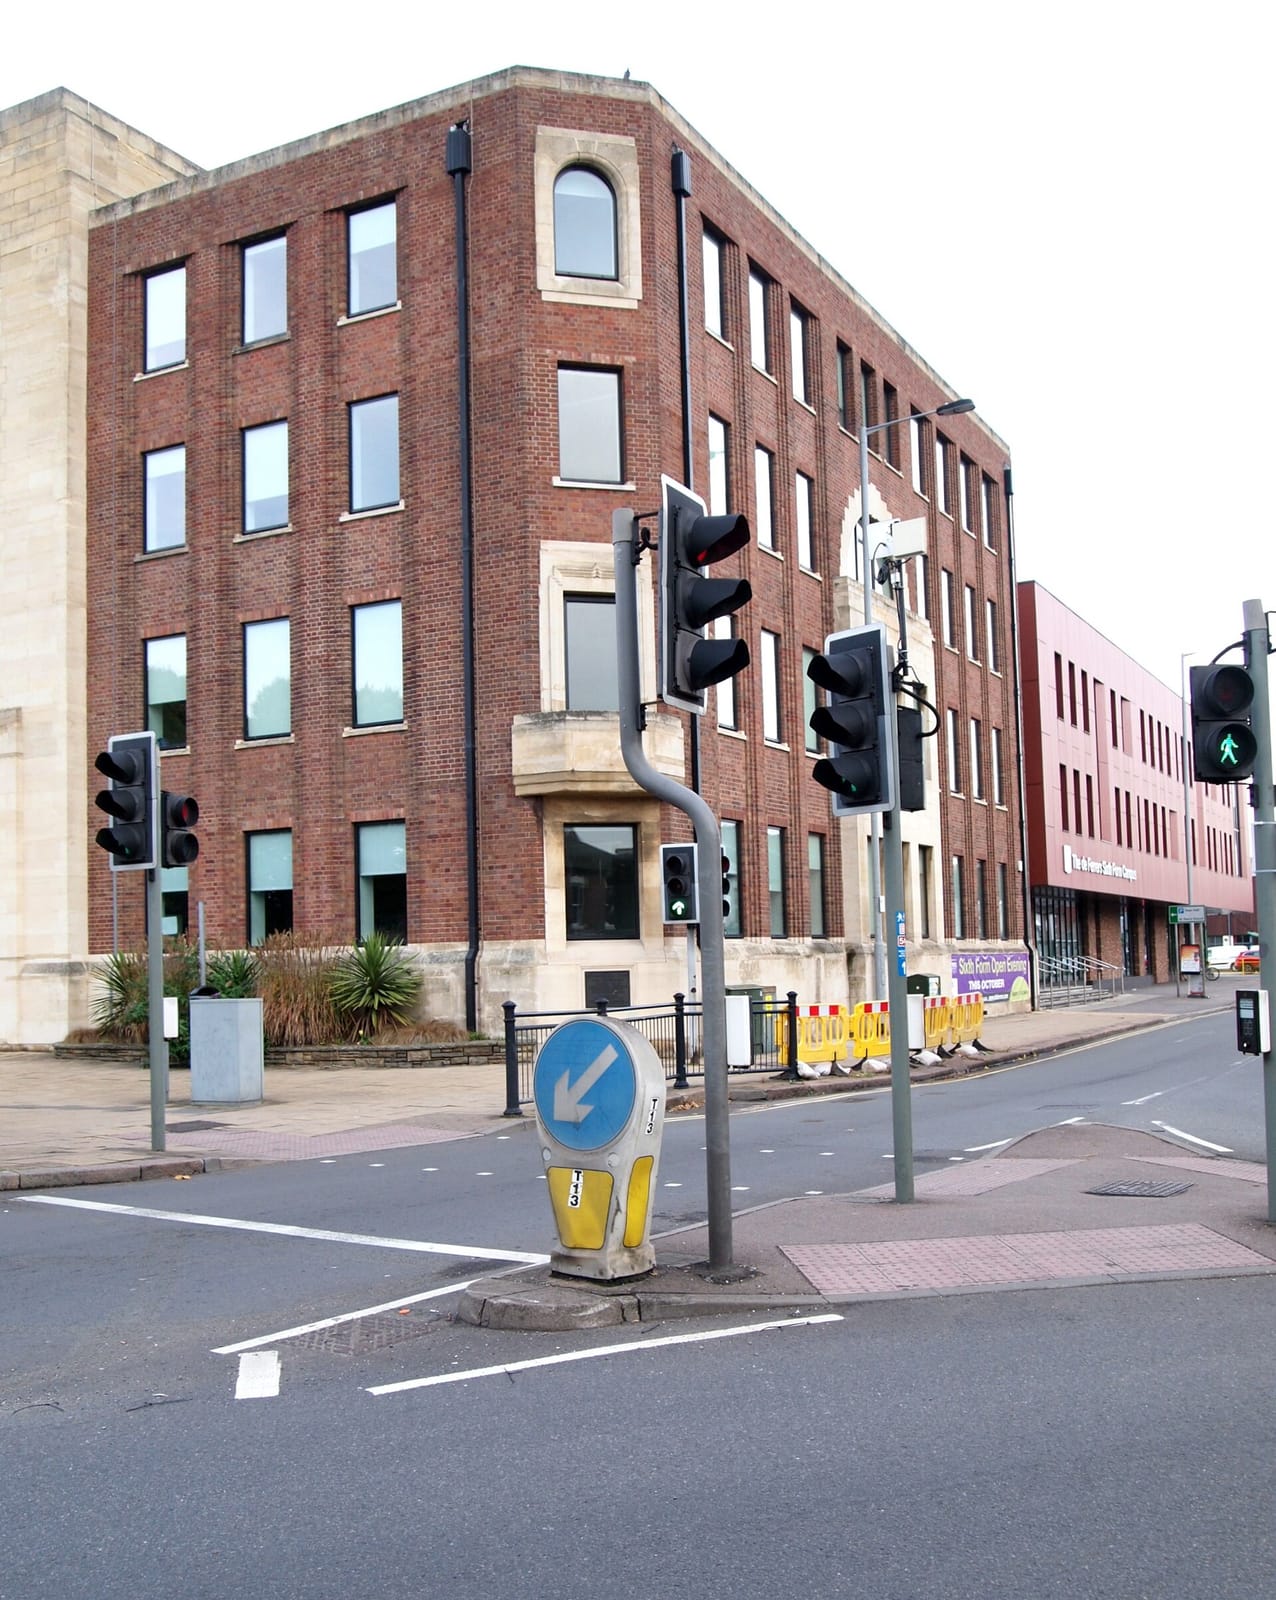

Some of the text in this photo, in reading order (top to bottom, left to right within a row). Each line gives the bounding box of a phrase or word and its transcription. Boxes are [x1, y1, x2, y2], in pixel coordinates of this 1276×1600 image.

[1072, 853, 1081, 870] The
[959, 957, 974, 974] Sixth
[975, 957, 991, 974] Form
[991, 957, 1006, 976] Open
[1007, 957, 1027, 975] Evening
[968, 978, 1005, 990] THIS OCTOBER
[570, 1170, 582, 1206] T13
